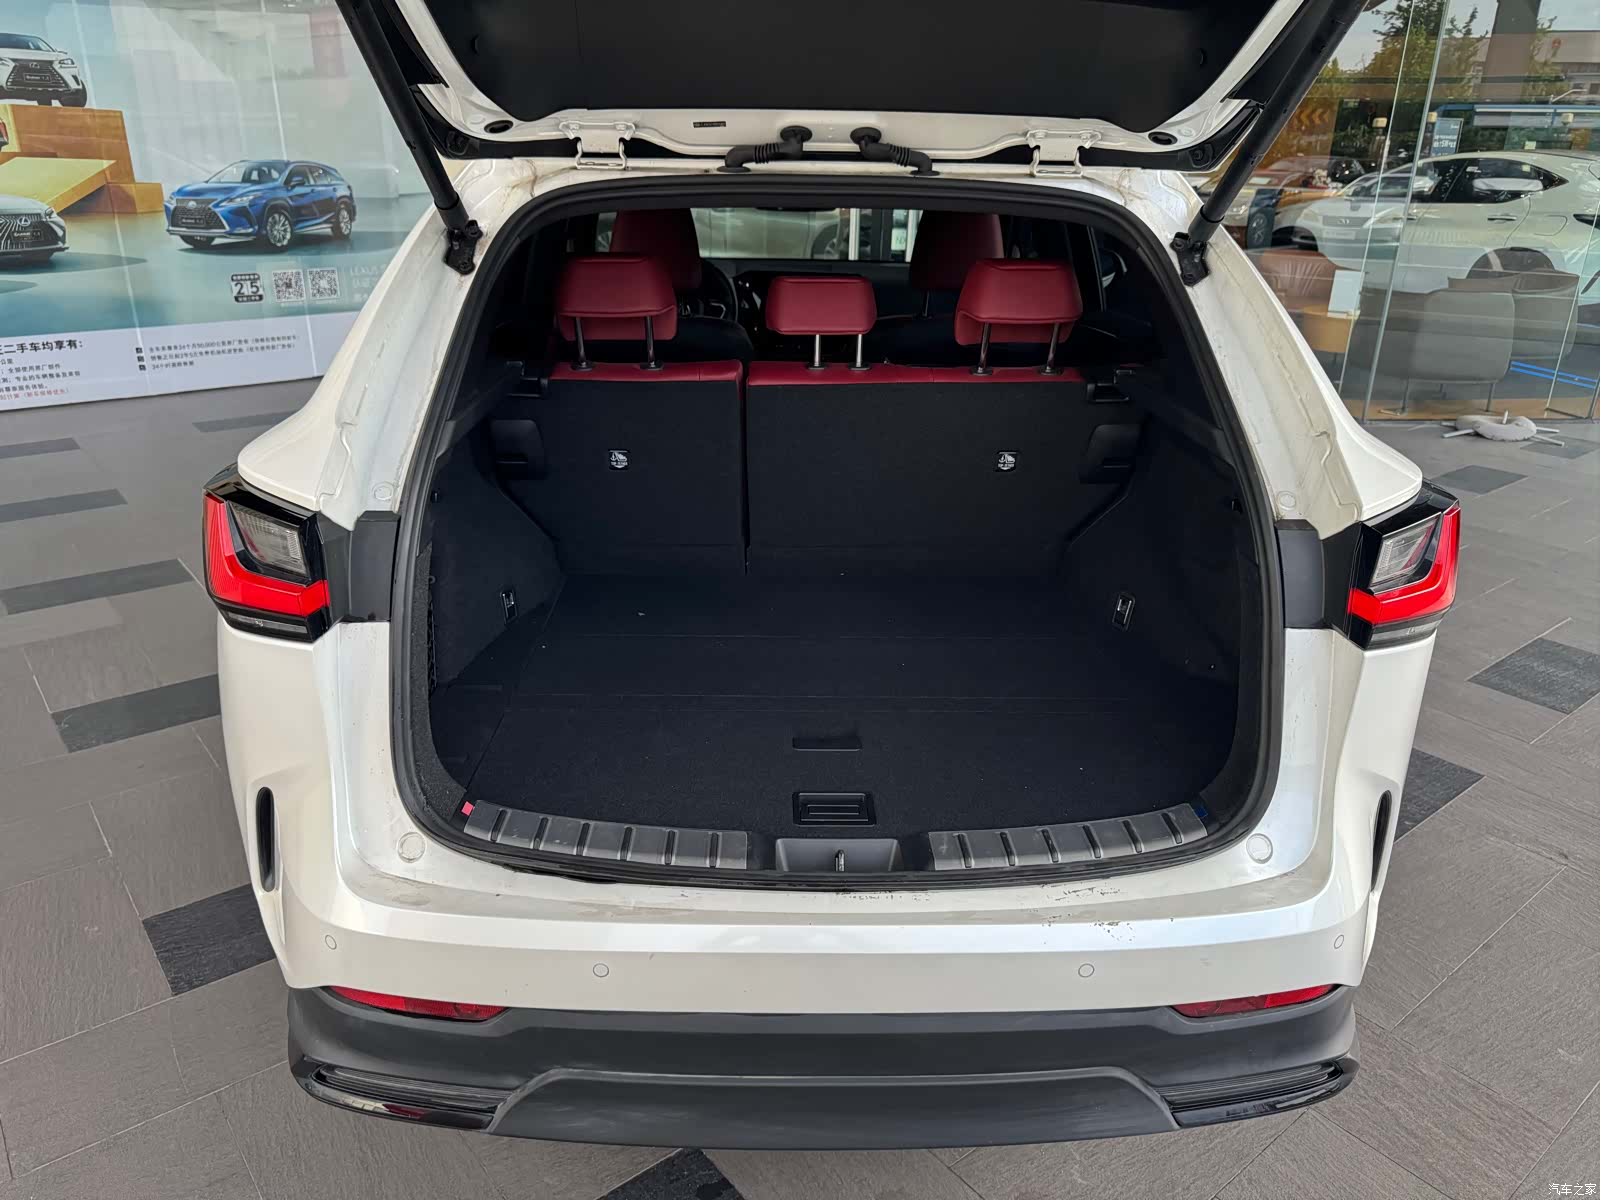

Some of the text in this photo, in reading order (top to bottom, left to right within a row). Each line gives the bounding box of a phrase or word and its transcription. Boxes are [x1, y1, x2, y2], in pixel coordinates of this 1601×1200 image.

[0, 339, 83, 354] 二手车均享有：
